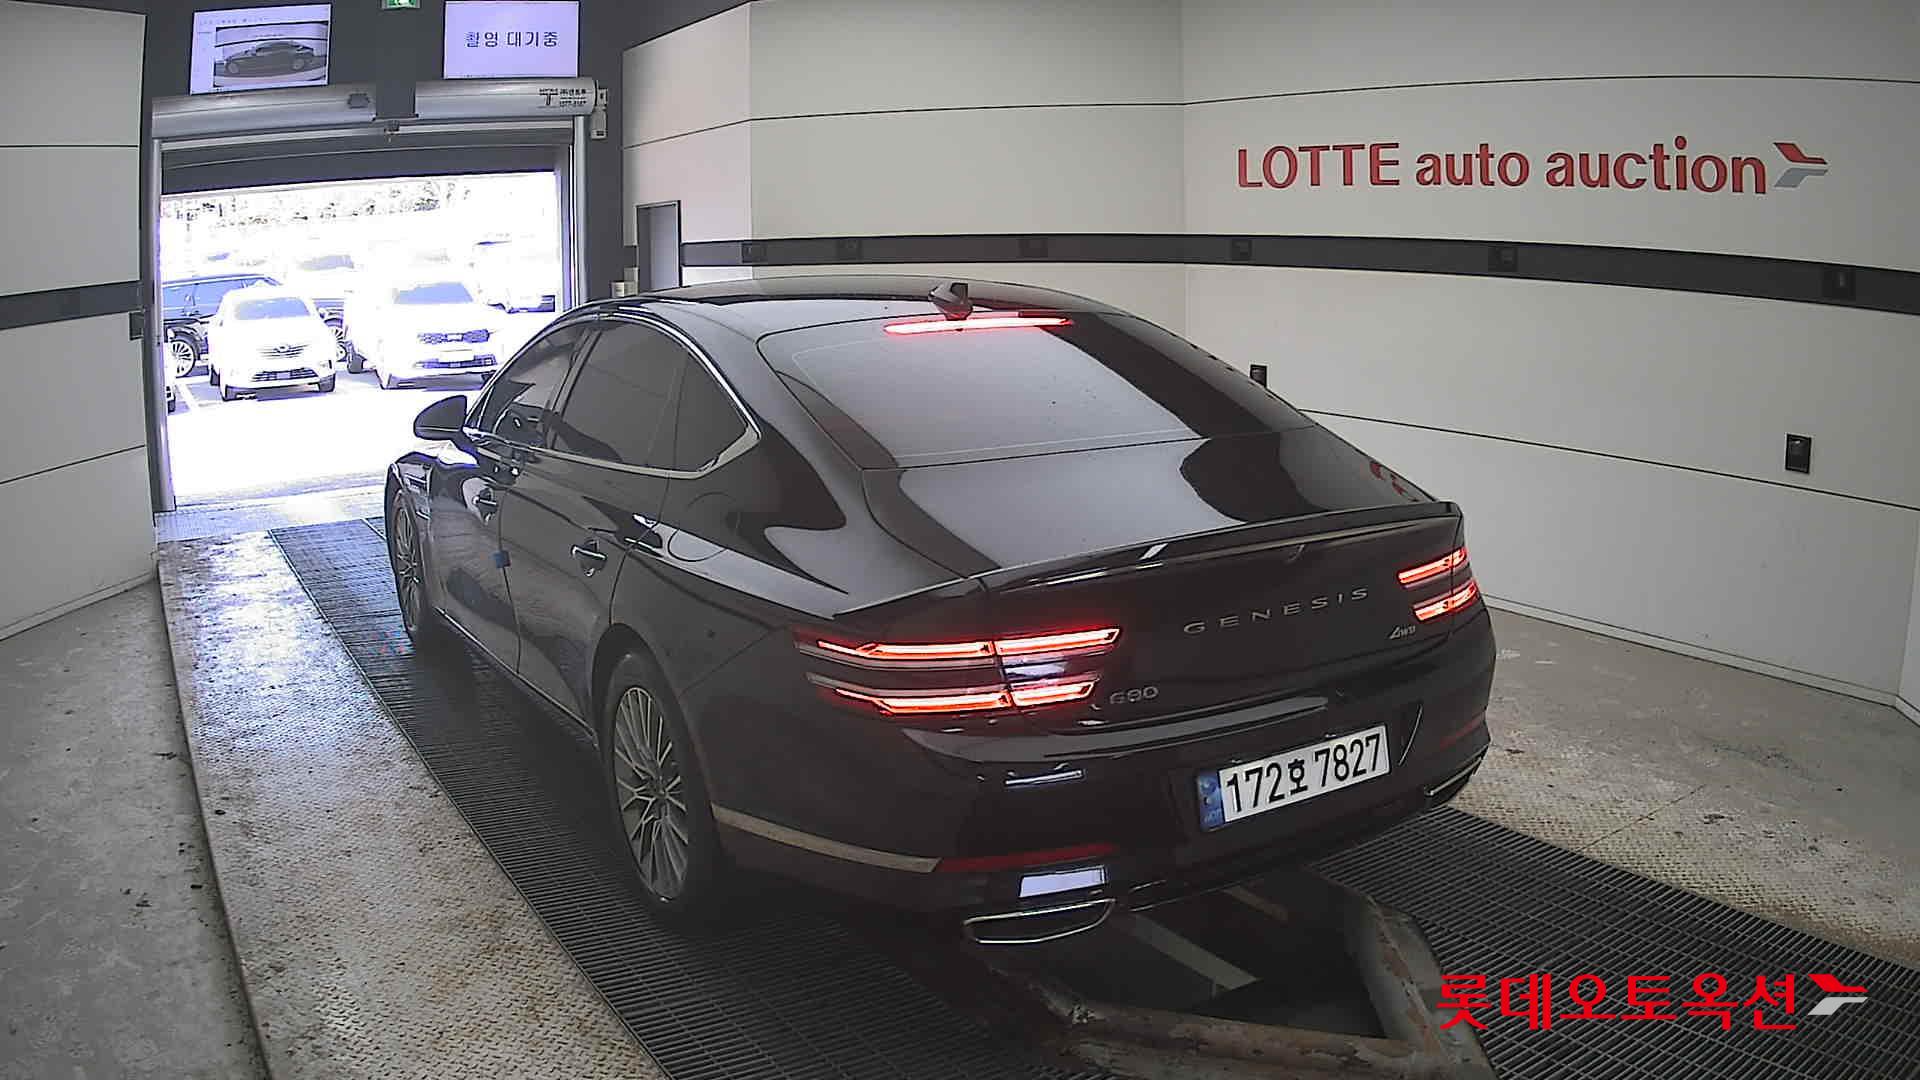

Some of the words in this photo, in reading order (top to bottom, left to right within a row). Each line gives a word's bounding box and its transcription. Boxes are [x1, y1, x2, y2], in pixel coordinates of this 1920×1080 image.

[507, 31, 558, 48] 대기중
[1237, 142, 1400, 189] LOTTE
[1415, 143, 1530, 187] auto
[1545, 135, 1766, 194] auction
[1183, 587, 1368, 634] GENESIS
[1110, 687, 1159, 704] G80
[1226, 758, 1308, 813] 172호
[1314, 733, 1380, 788] 7827
